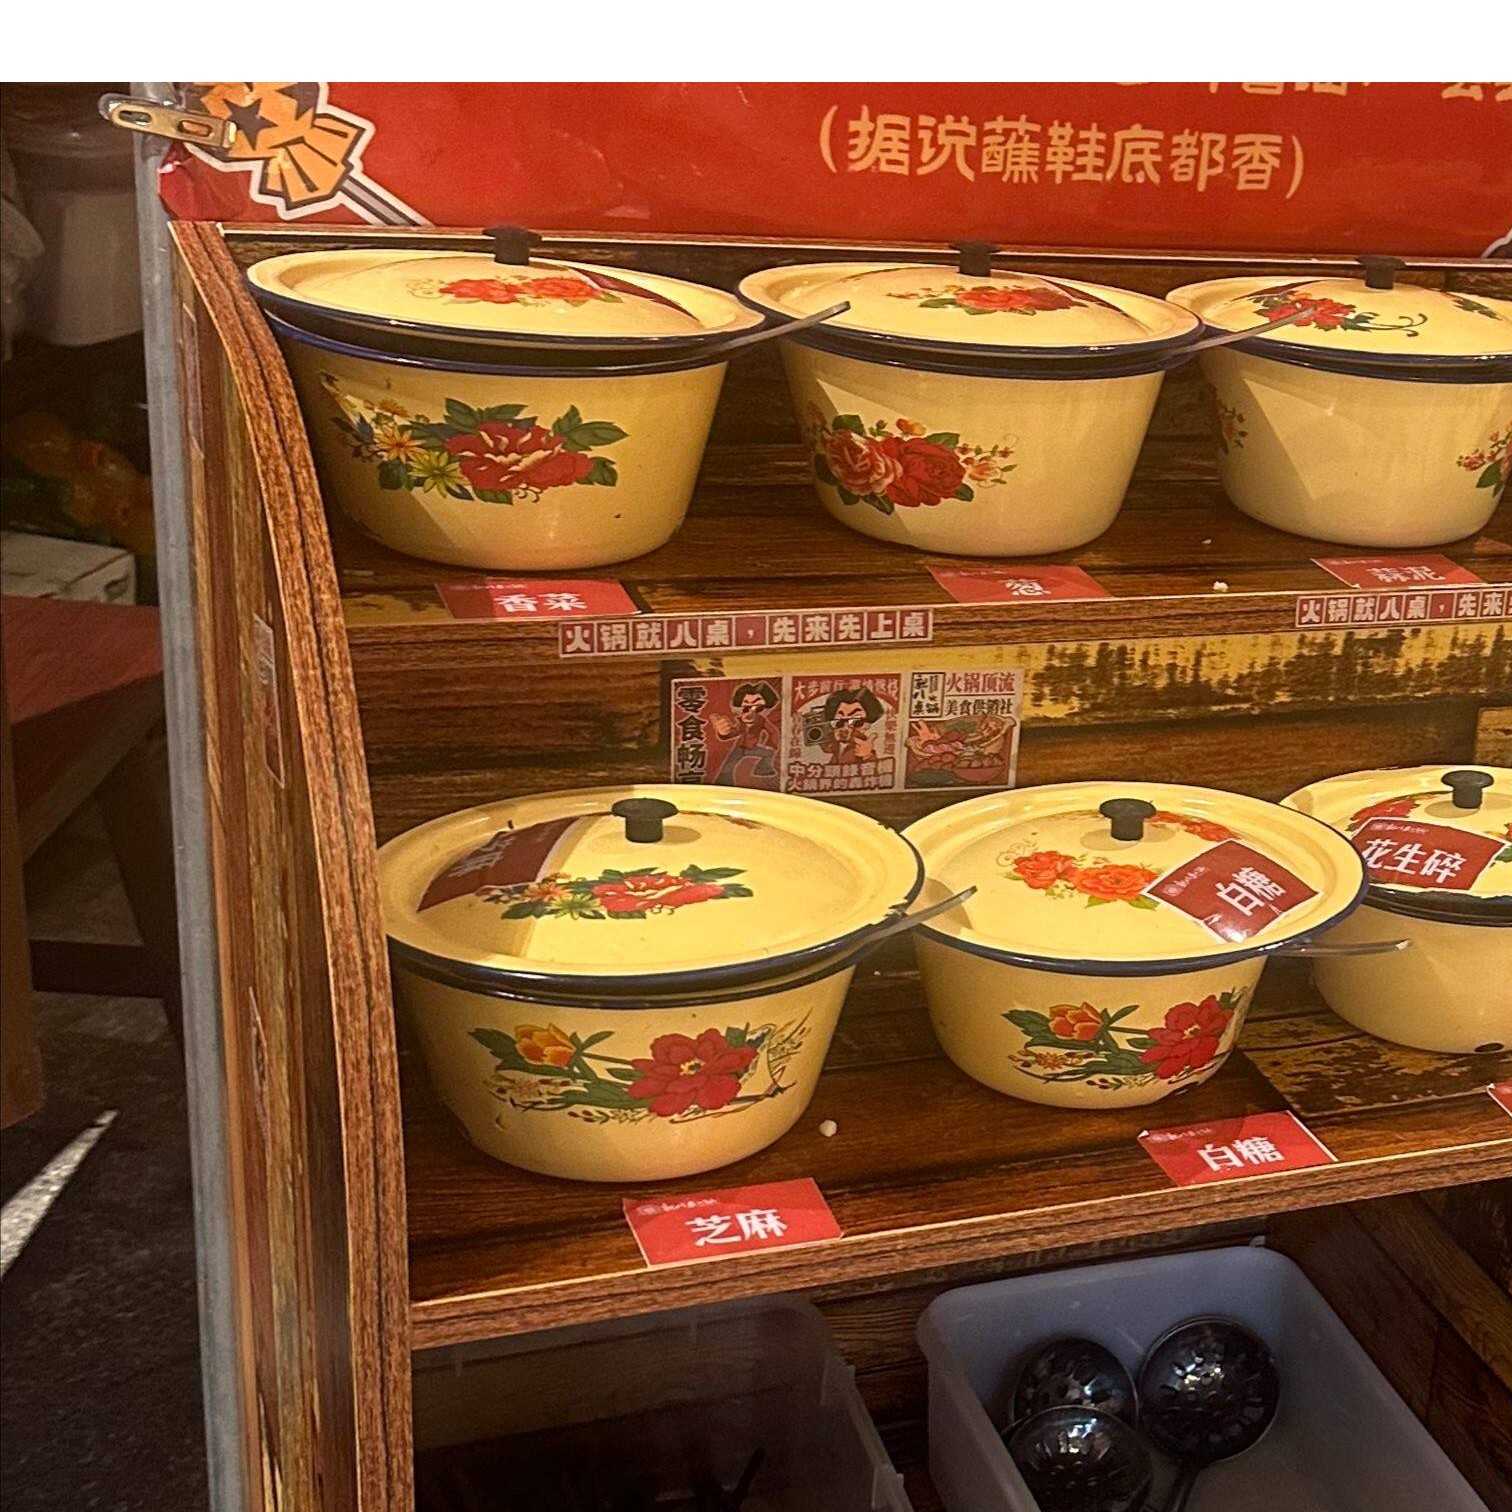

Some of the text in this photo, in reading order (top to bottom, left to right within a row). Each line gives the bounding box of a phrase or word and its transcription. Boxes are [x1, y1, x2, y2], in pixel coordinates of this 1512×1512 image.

[1366, 564, 1446, 583] 蒜泥
[493, 592, 588, 613] 香菜
[676, 686, 707, 784] 零食畅
[1361, 838, 1468, 884] 花生碎
[1215, 866, 1288, 917] 白糖
[1197, 1135, 1286, 1172] 白糖
[684, 1208, 788, 1247] 芝麻
